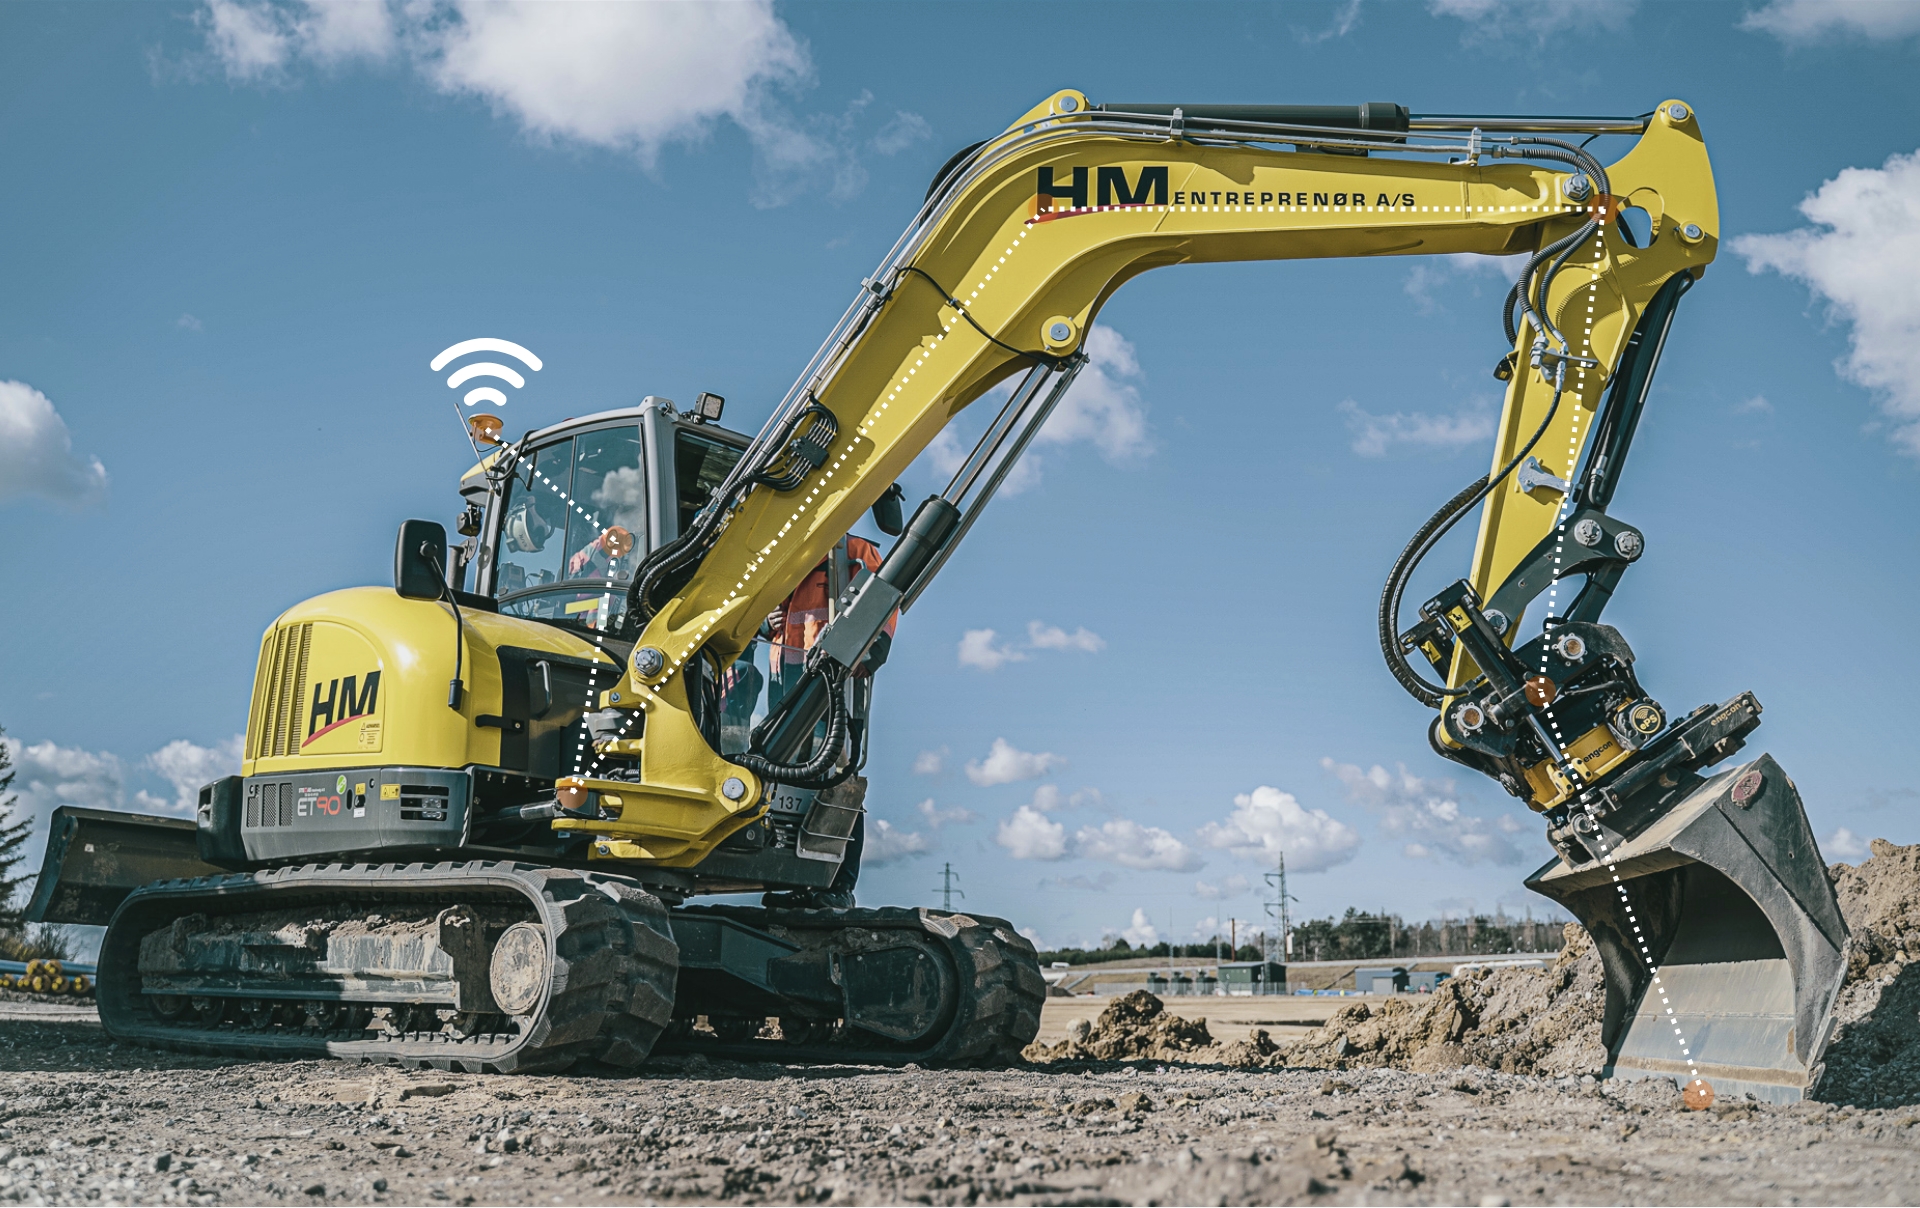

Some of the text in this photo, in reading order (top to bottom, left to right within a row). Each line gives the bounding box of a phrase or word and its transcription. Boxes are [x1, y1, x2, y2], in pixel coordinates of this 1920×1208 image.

[1037, 165, 1416, 214] HM ENTREPRENØR A/S
[308, 670, 381, 738] HM
[1640, 714, 1658, 730] ePS
[1583, 740, 1613, 763] engcon
[297, 795, 341, 816] ET90
[779, 795, 803, 811] 137
